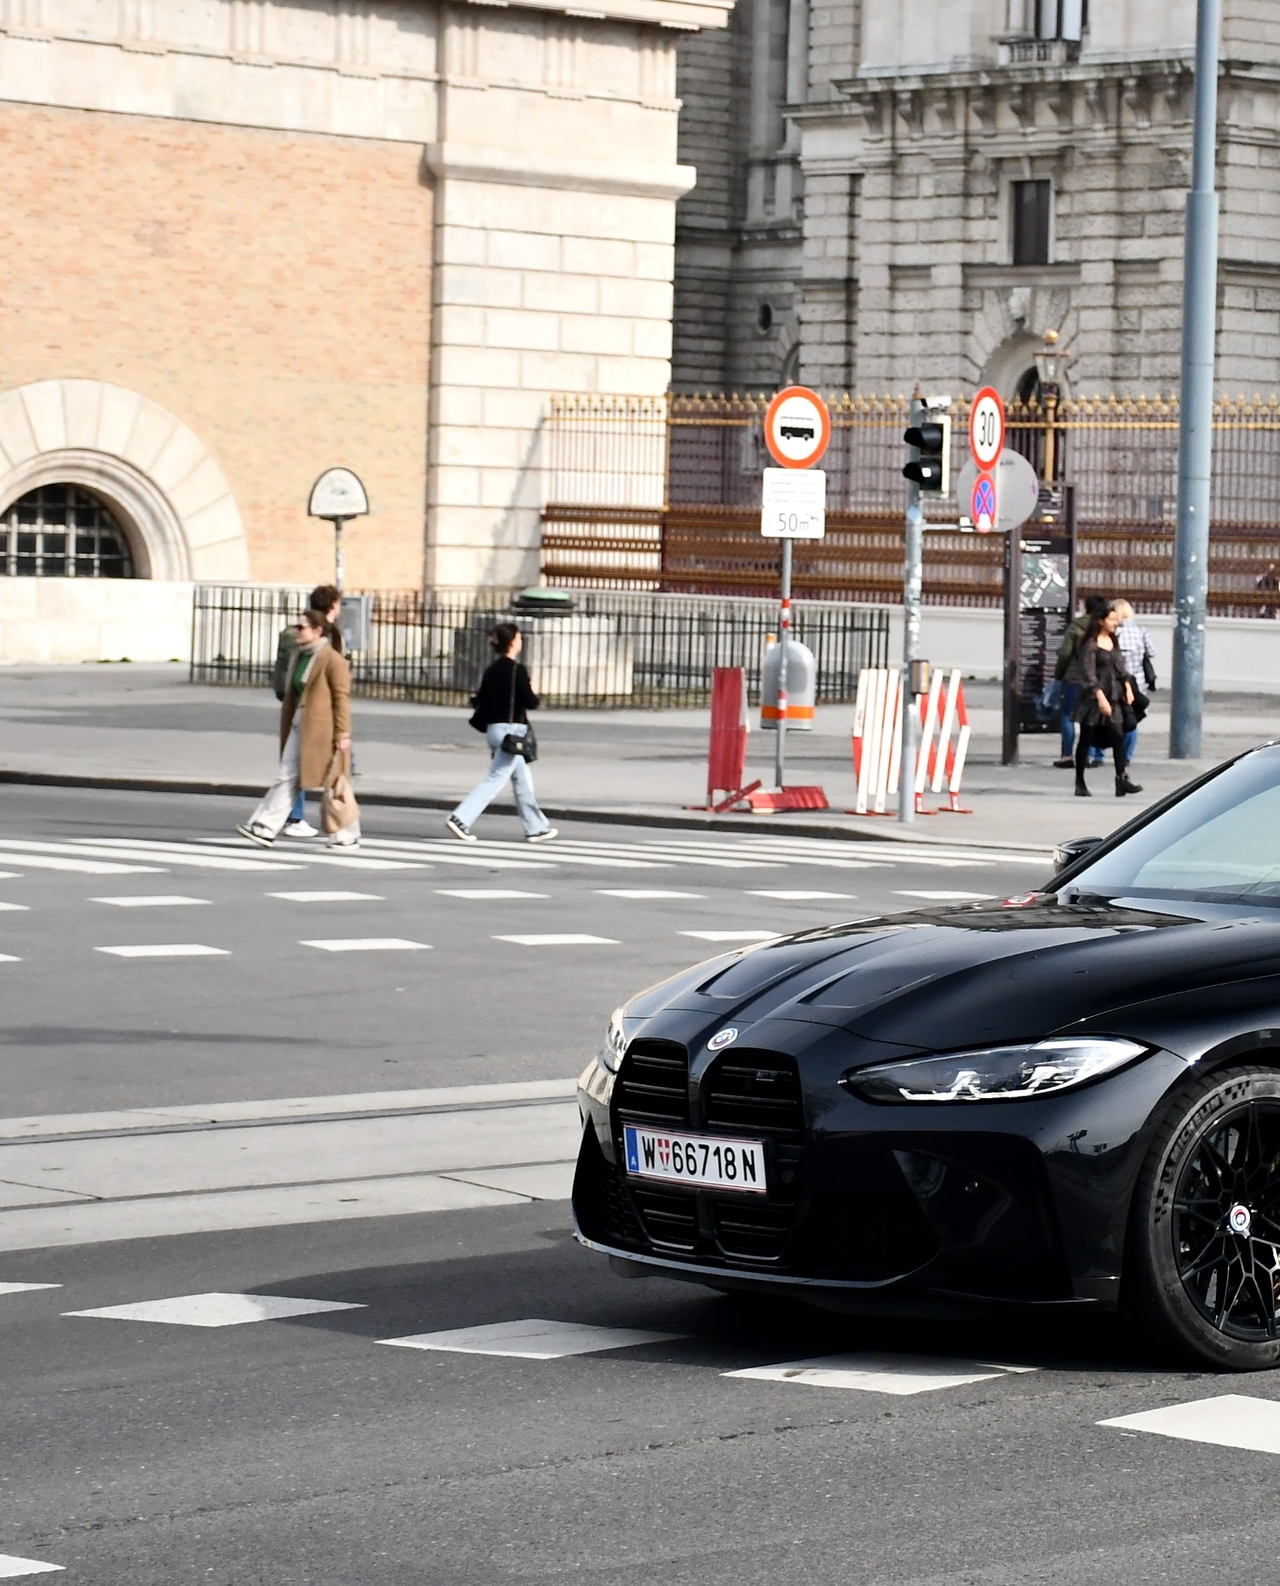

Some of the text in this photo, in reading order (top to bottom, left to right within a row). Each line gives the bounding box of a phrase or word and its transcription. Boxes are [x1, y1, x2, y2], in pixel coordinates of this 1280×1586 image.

[979, 411, 995, 448] 30
[1170, 1093, 1223, 1164] MICHELIN
[642, 1135, 656, 1169] W
